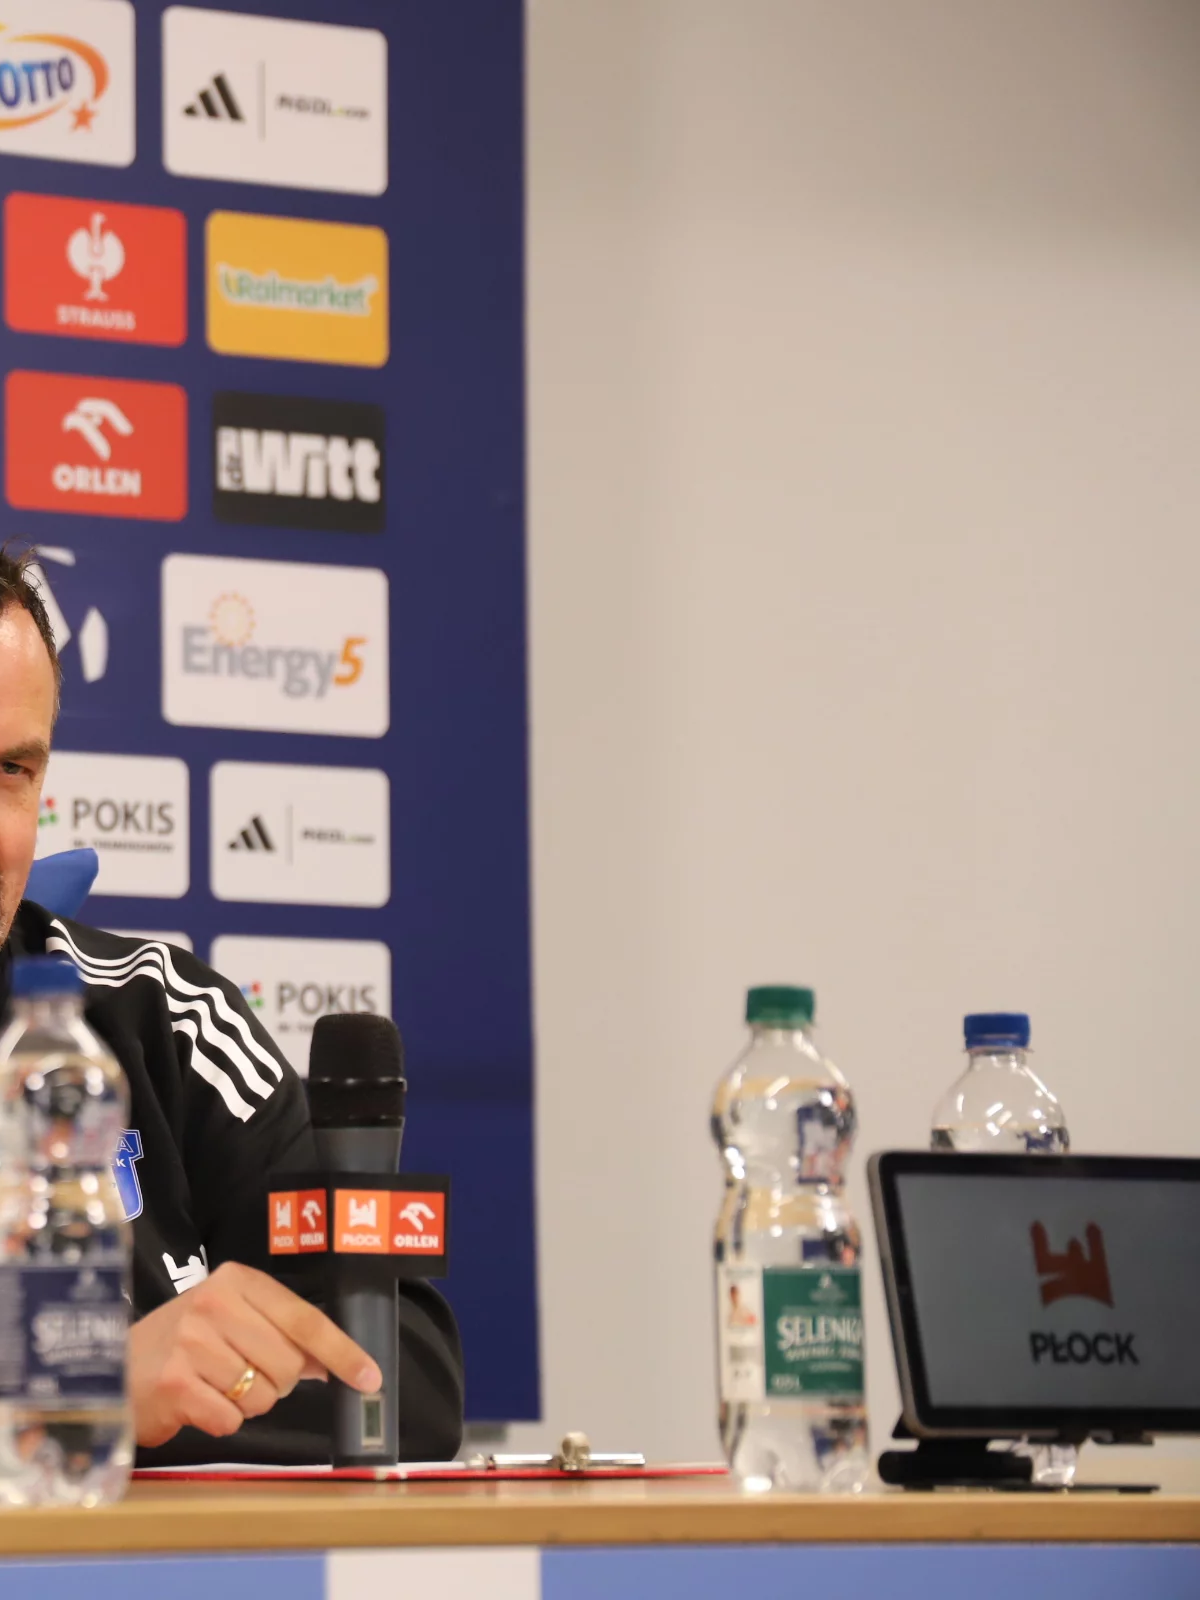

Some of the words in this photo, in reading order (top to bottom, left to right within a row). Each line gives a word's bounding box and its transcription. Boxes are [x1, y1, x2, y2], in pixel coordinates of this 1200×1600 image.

[56, 305, 136, 331] STRAUSS
[52, 464, 142, 497] ORLEN
[72, 798, 175, 836] POKIS
[277, 982, 378, 1016] POKIS
[394, 1234, 439, 1249] ORLEN
[1029, 1331, 1141, 1367] PŁOCK
